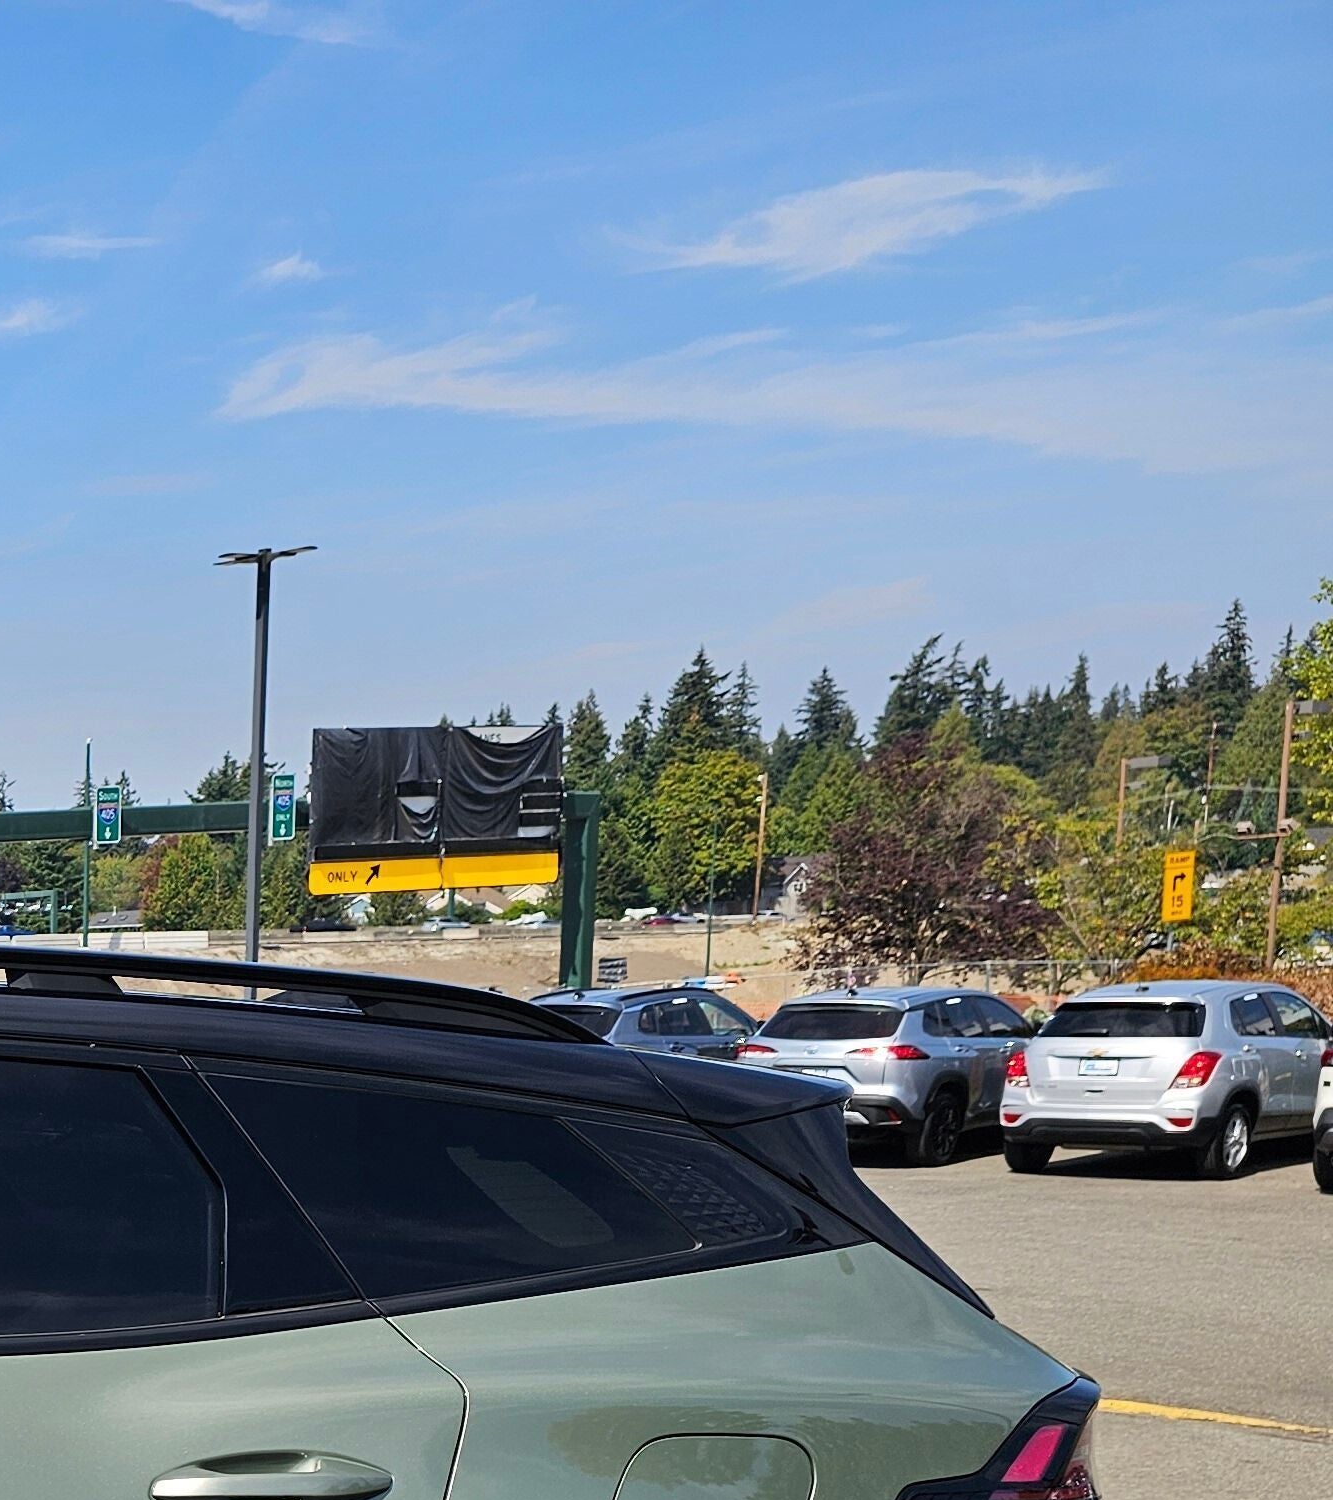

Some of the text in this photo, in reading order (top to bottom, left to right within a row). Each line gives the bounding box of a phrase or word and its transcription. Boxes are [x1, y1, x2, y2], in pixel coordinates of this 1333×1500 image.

[277, 795, 291, 805] 405
[100, 808, 115, 819] 405
[276, 813, 291, 822] ONLY
[327, 870, 358, 883] ONLY
[1172, 894, 1183, 908] 15
